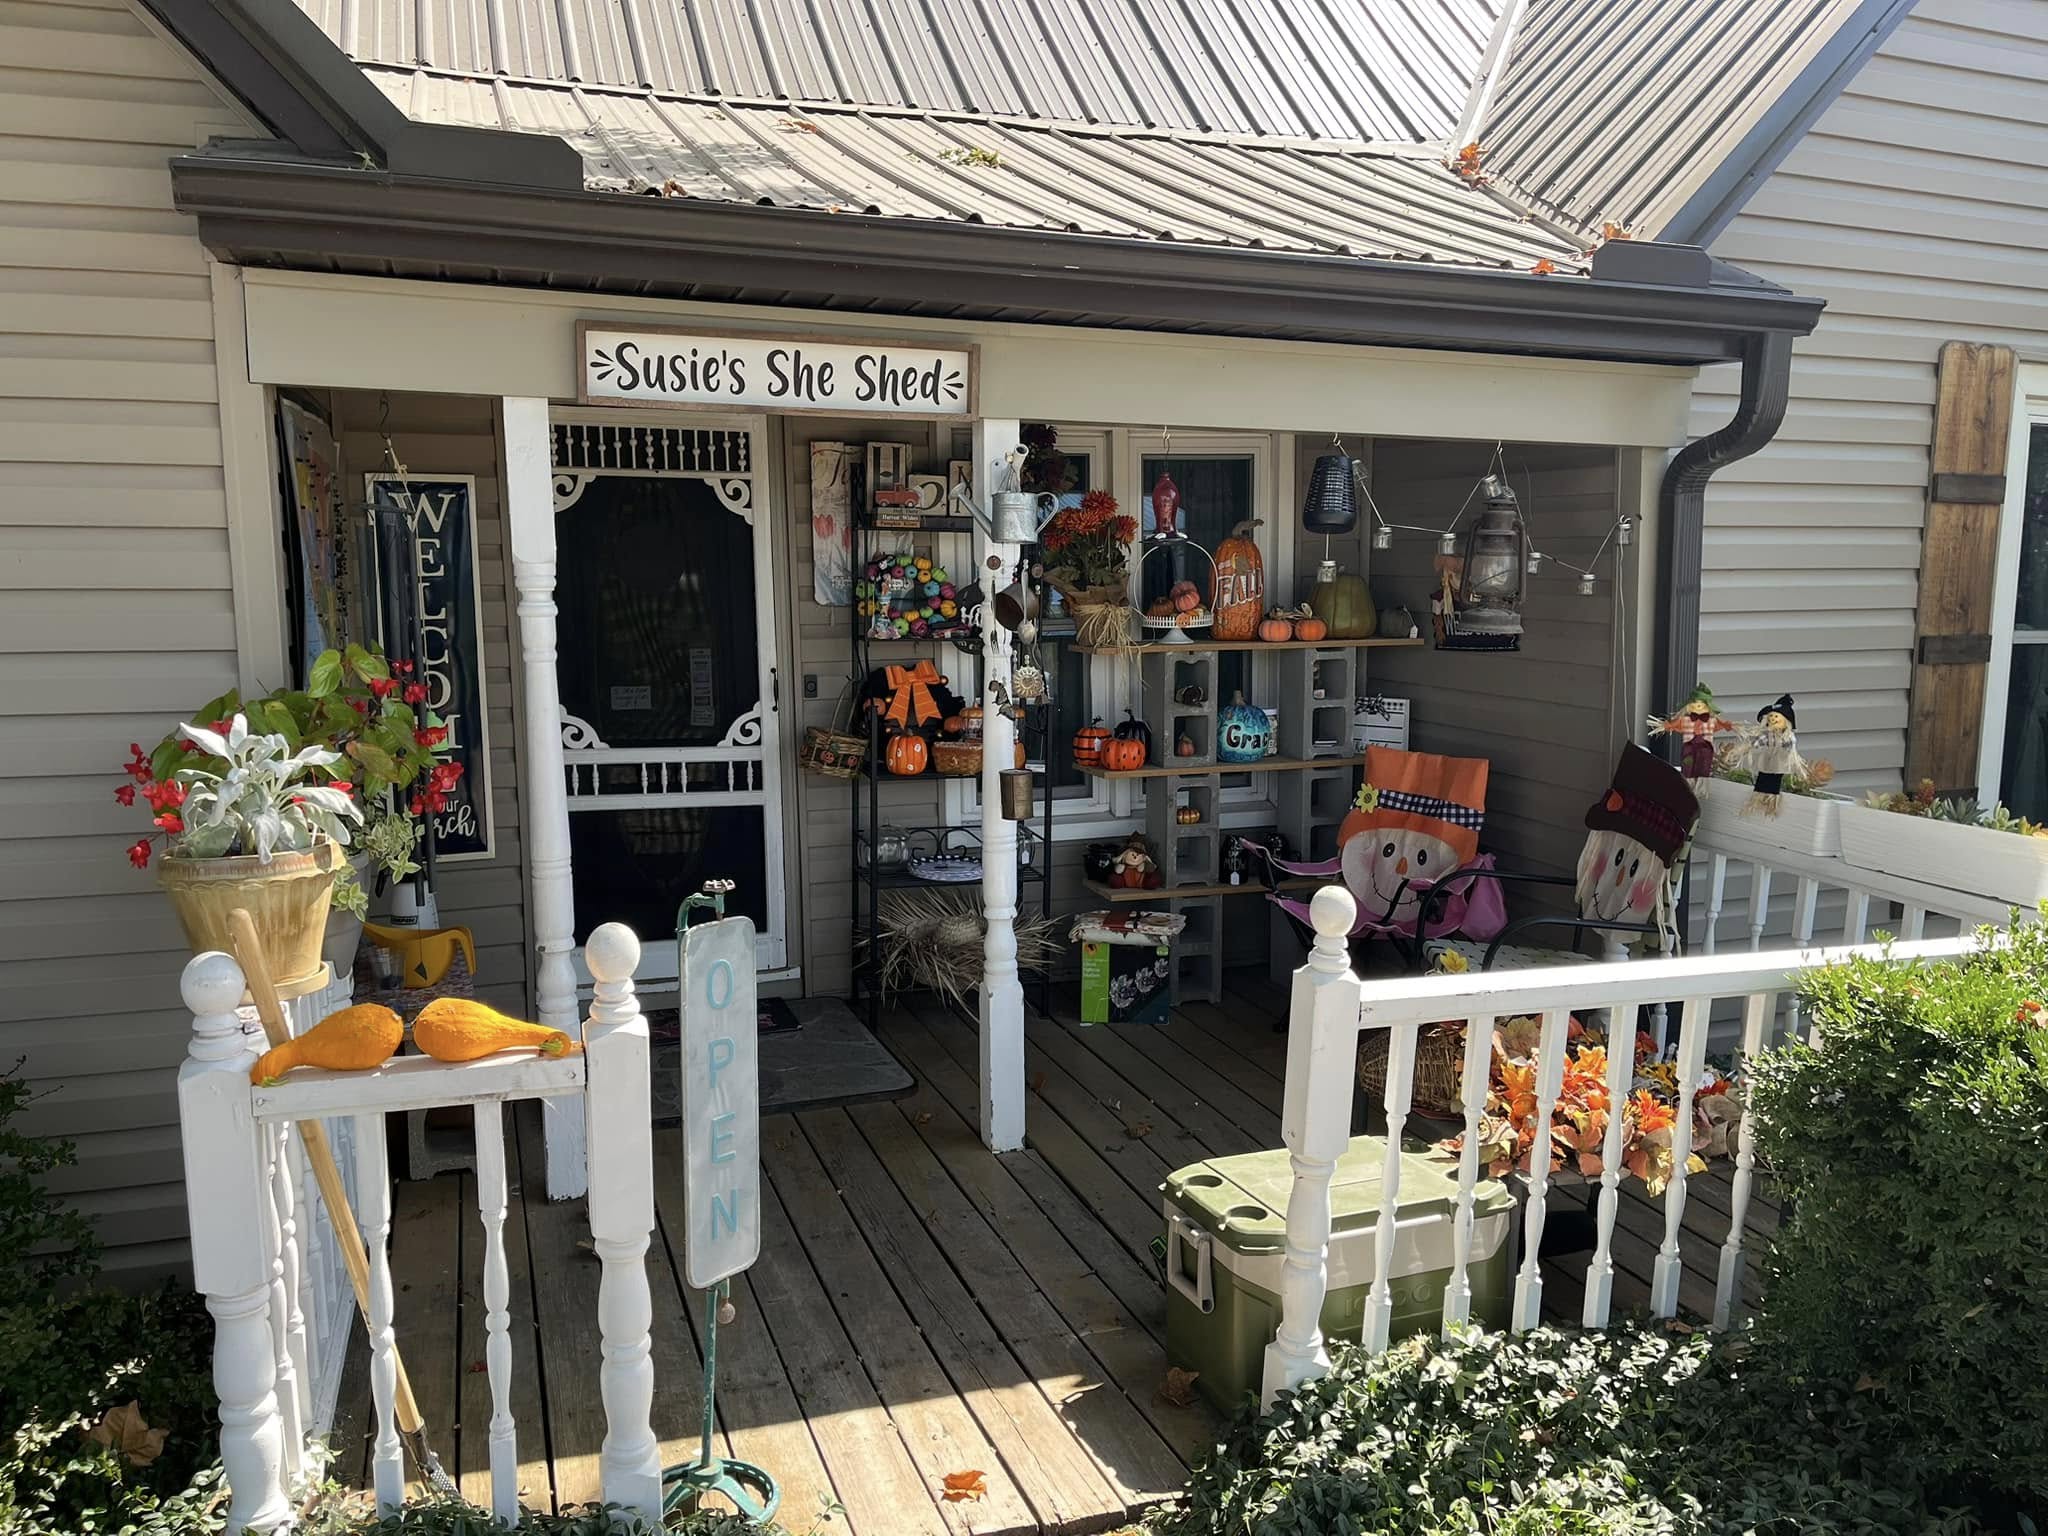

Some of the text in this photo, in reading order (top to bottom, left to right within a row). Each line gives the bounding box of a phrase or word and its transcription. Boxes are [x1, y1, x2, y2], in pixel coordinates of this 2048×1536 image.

[614, 341, 943, 407] Susie's She Shed
[1217, 568, 1264, 610] FALL
[706, 958, 739, 1241] OPEN
